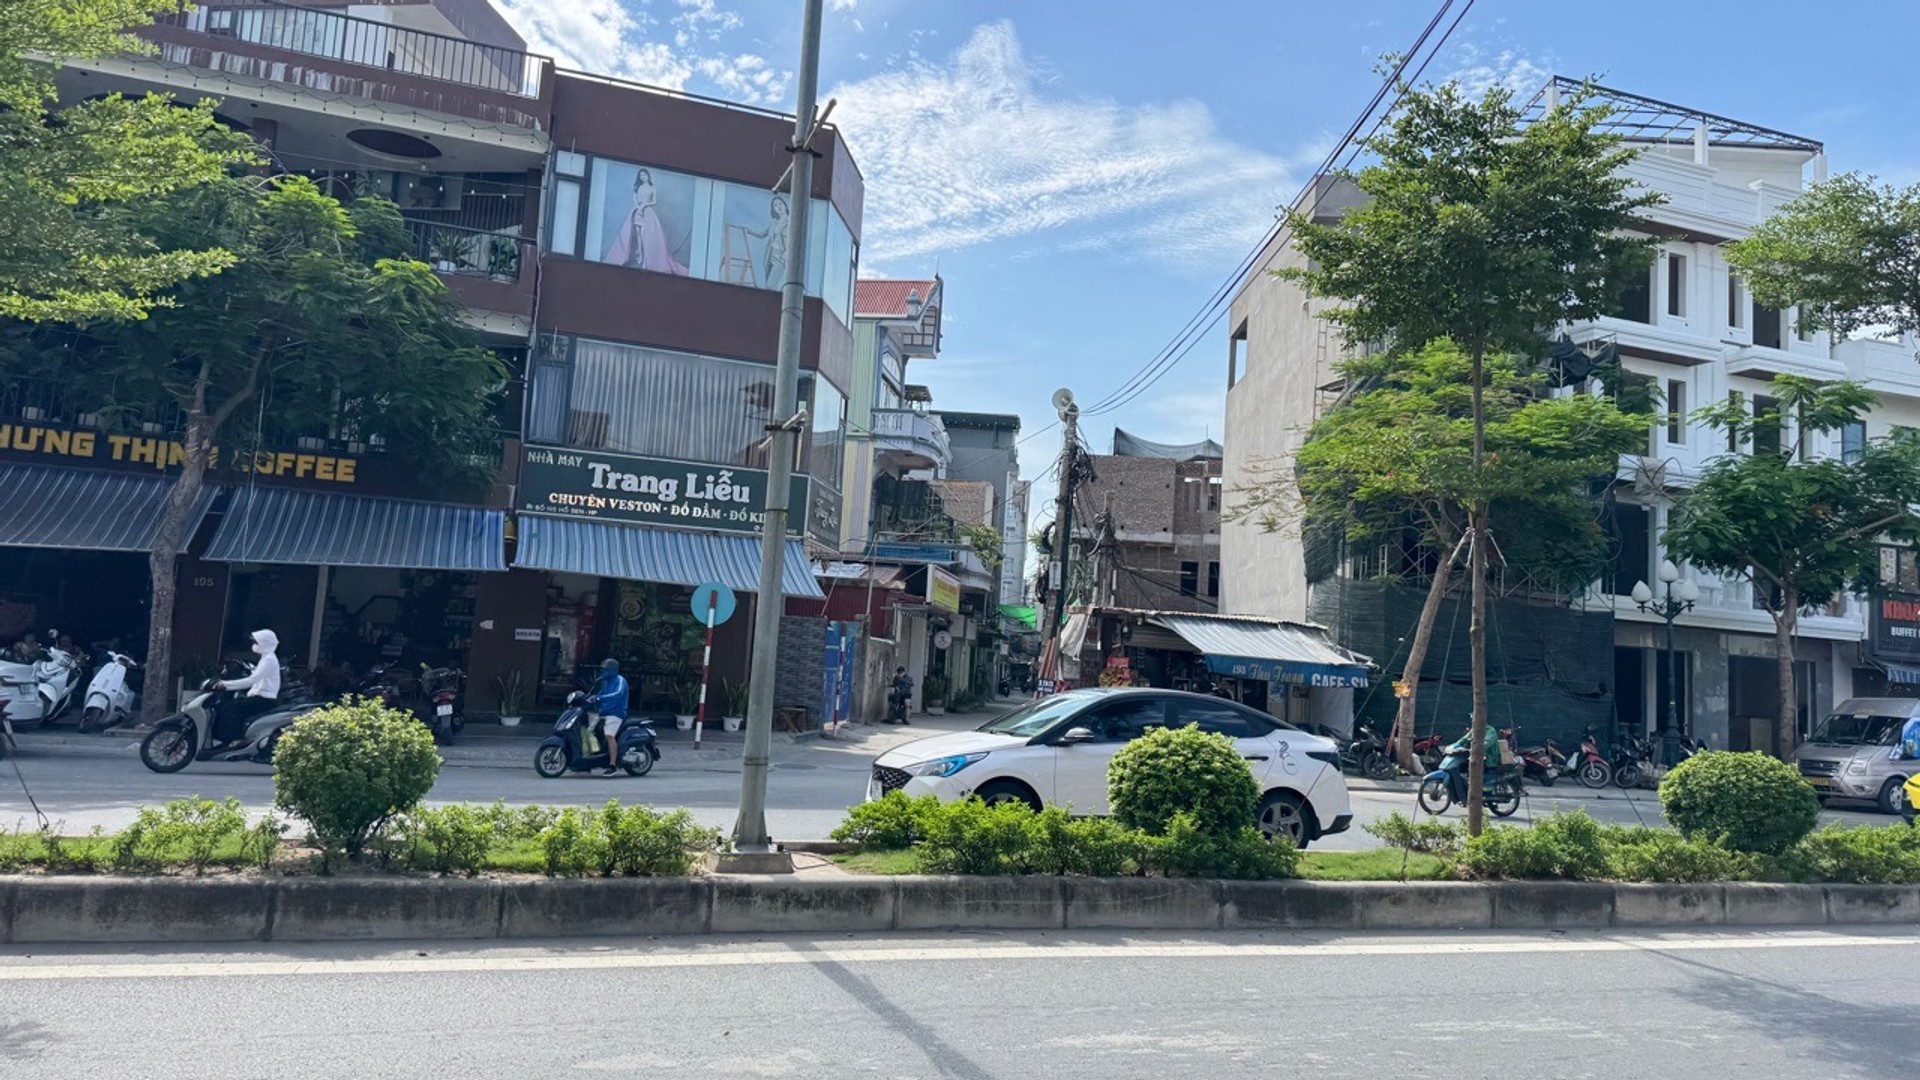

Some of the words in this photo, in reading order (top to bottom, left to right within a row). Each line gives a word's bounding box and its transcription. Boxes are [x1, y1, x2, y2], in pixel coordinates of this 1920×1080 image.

[107, 434, 219, 470] THỊN
[231, 449, 357, 483] OFFEE
[527, 451, 554, 465] NHÀ
[557, 454, 583, 468] MAY
[587, 462, 679, 503] Trang
[684, 469, 751, 504] Liễu
[548, 492, 606, 509] CHUYÊN
[608, 498, 662, 514] VESTON
